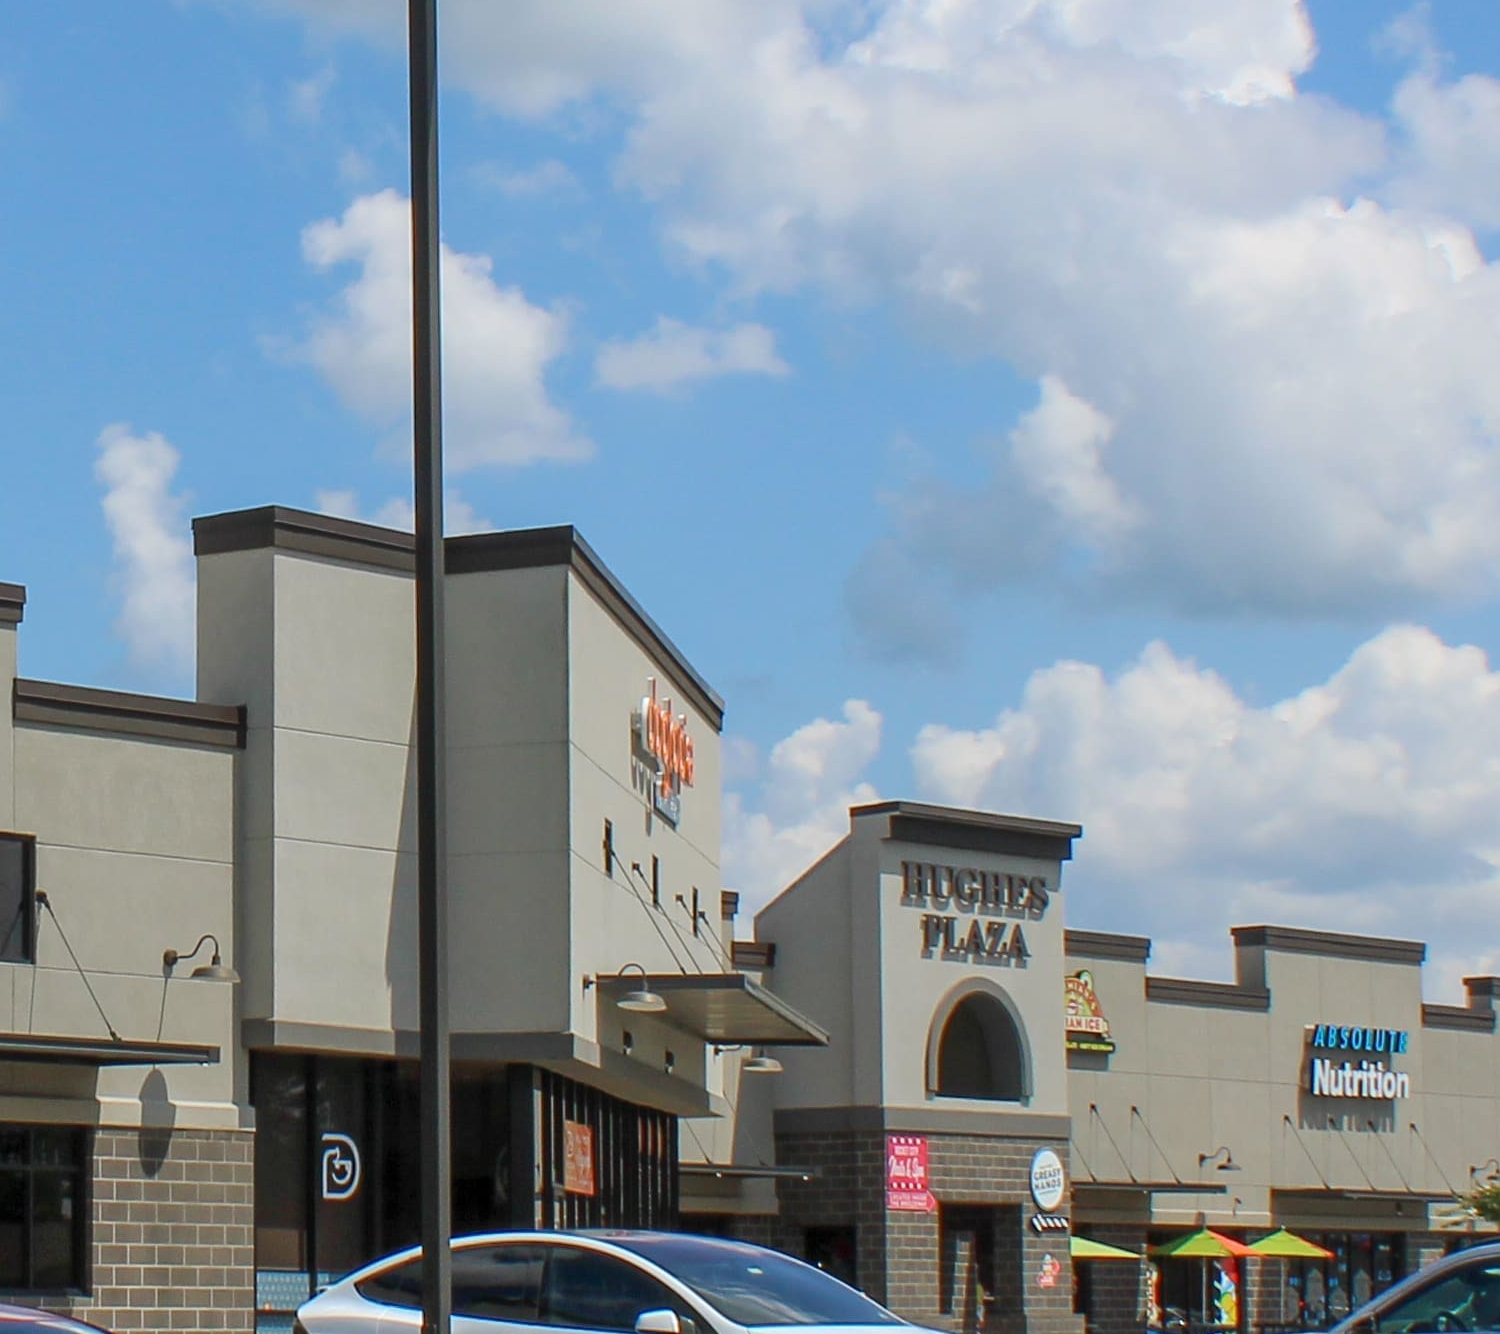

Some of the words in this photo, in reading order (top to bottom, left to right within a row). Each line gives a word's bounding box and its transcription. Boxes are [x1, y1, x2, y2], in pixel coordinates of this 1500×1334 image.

[901, 860, 1049, 913] HUGHES
[920, 914, 1032, 959] PLAZA
[1313, 1024, 1408, 1054] ABSOLUTE
[1312, 1057, 1409, 1099] Nutrition
